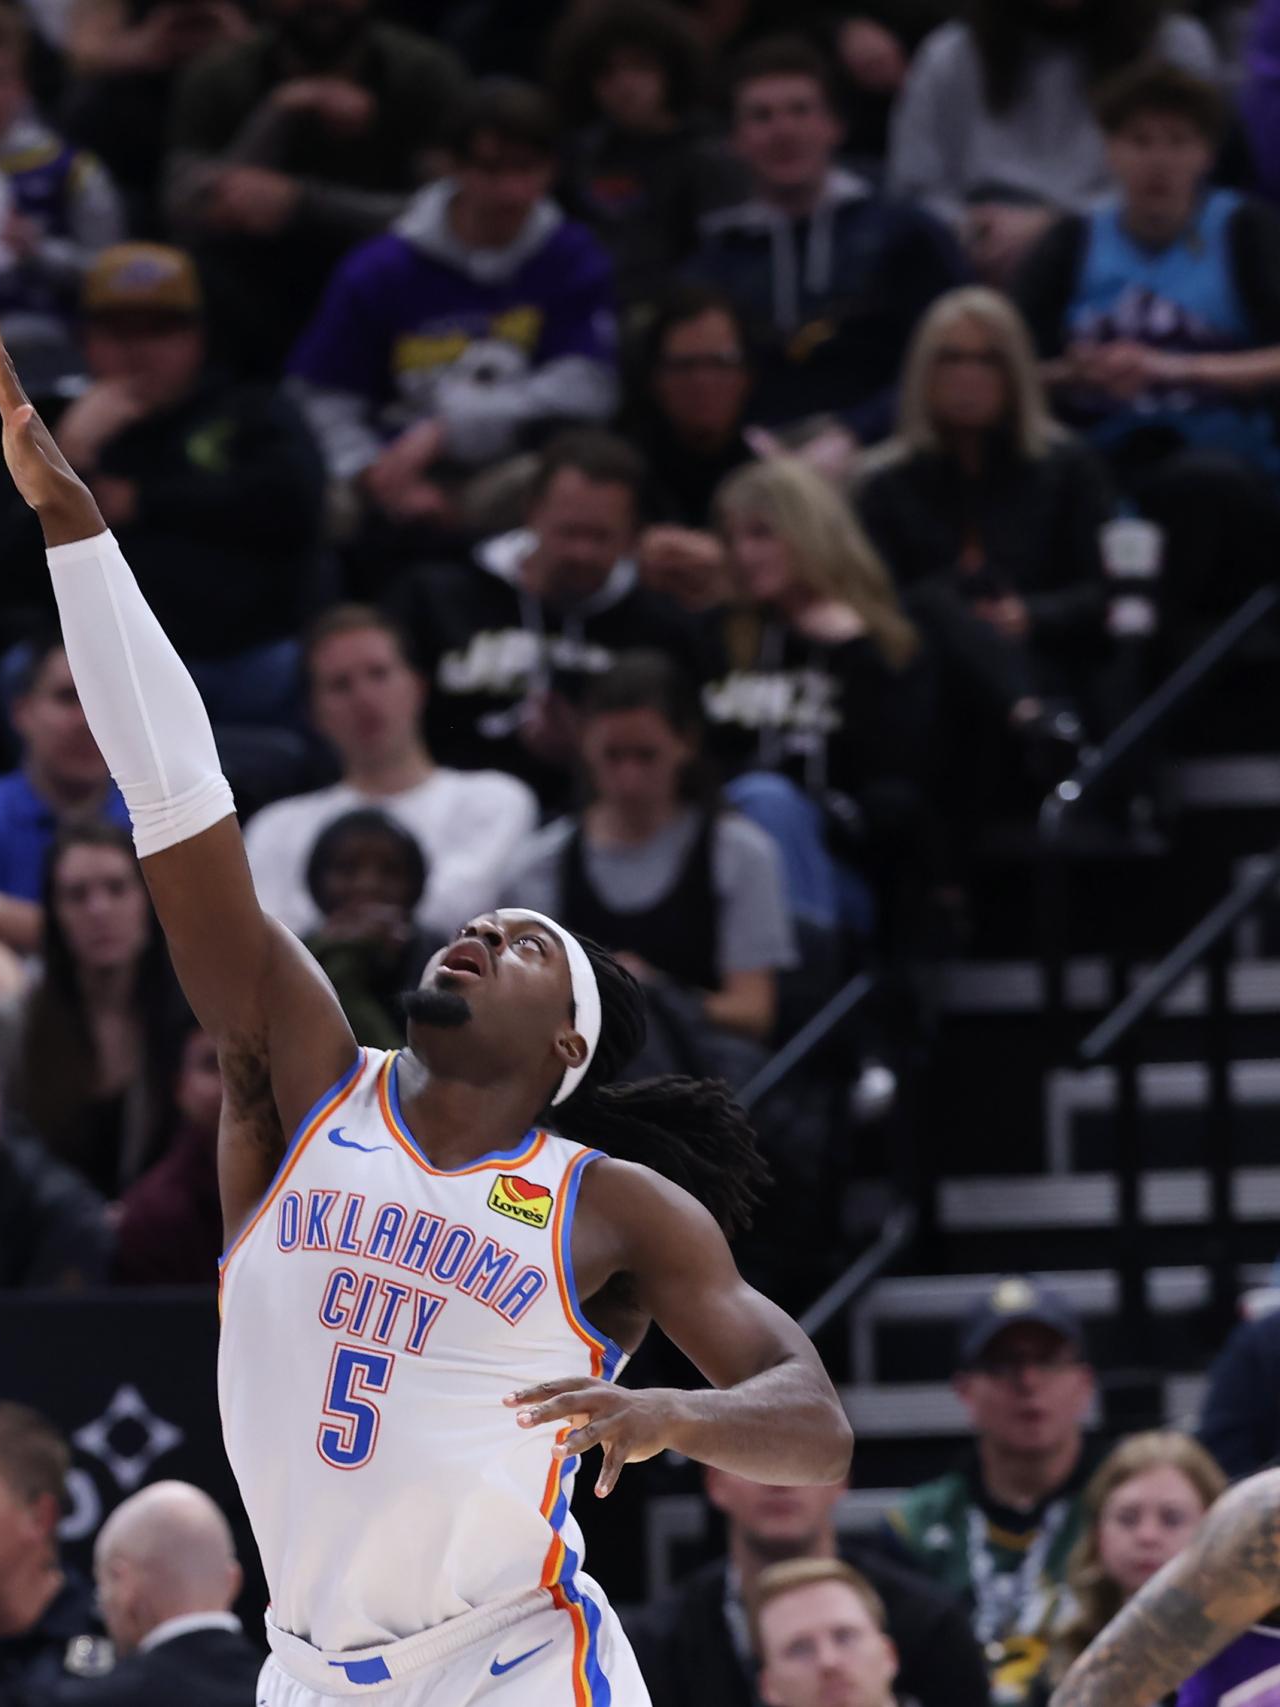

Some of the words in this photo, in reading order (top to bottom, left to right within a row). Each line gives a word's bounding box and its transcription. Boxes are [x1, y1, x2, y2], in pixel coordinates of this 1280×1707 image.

[277, 1189, 548, 1328] OKLAHOMA
[319, 1266, 448, 1357] CITY
[316, 1341, 396, 1471] 5
